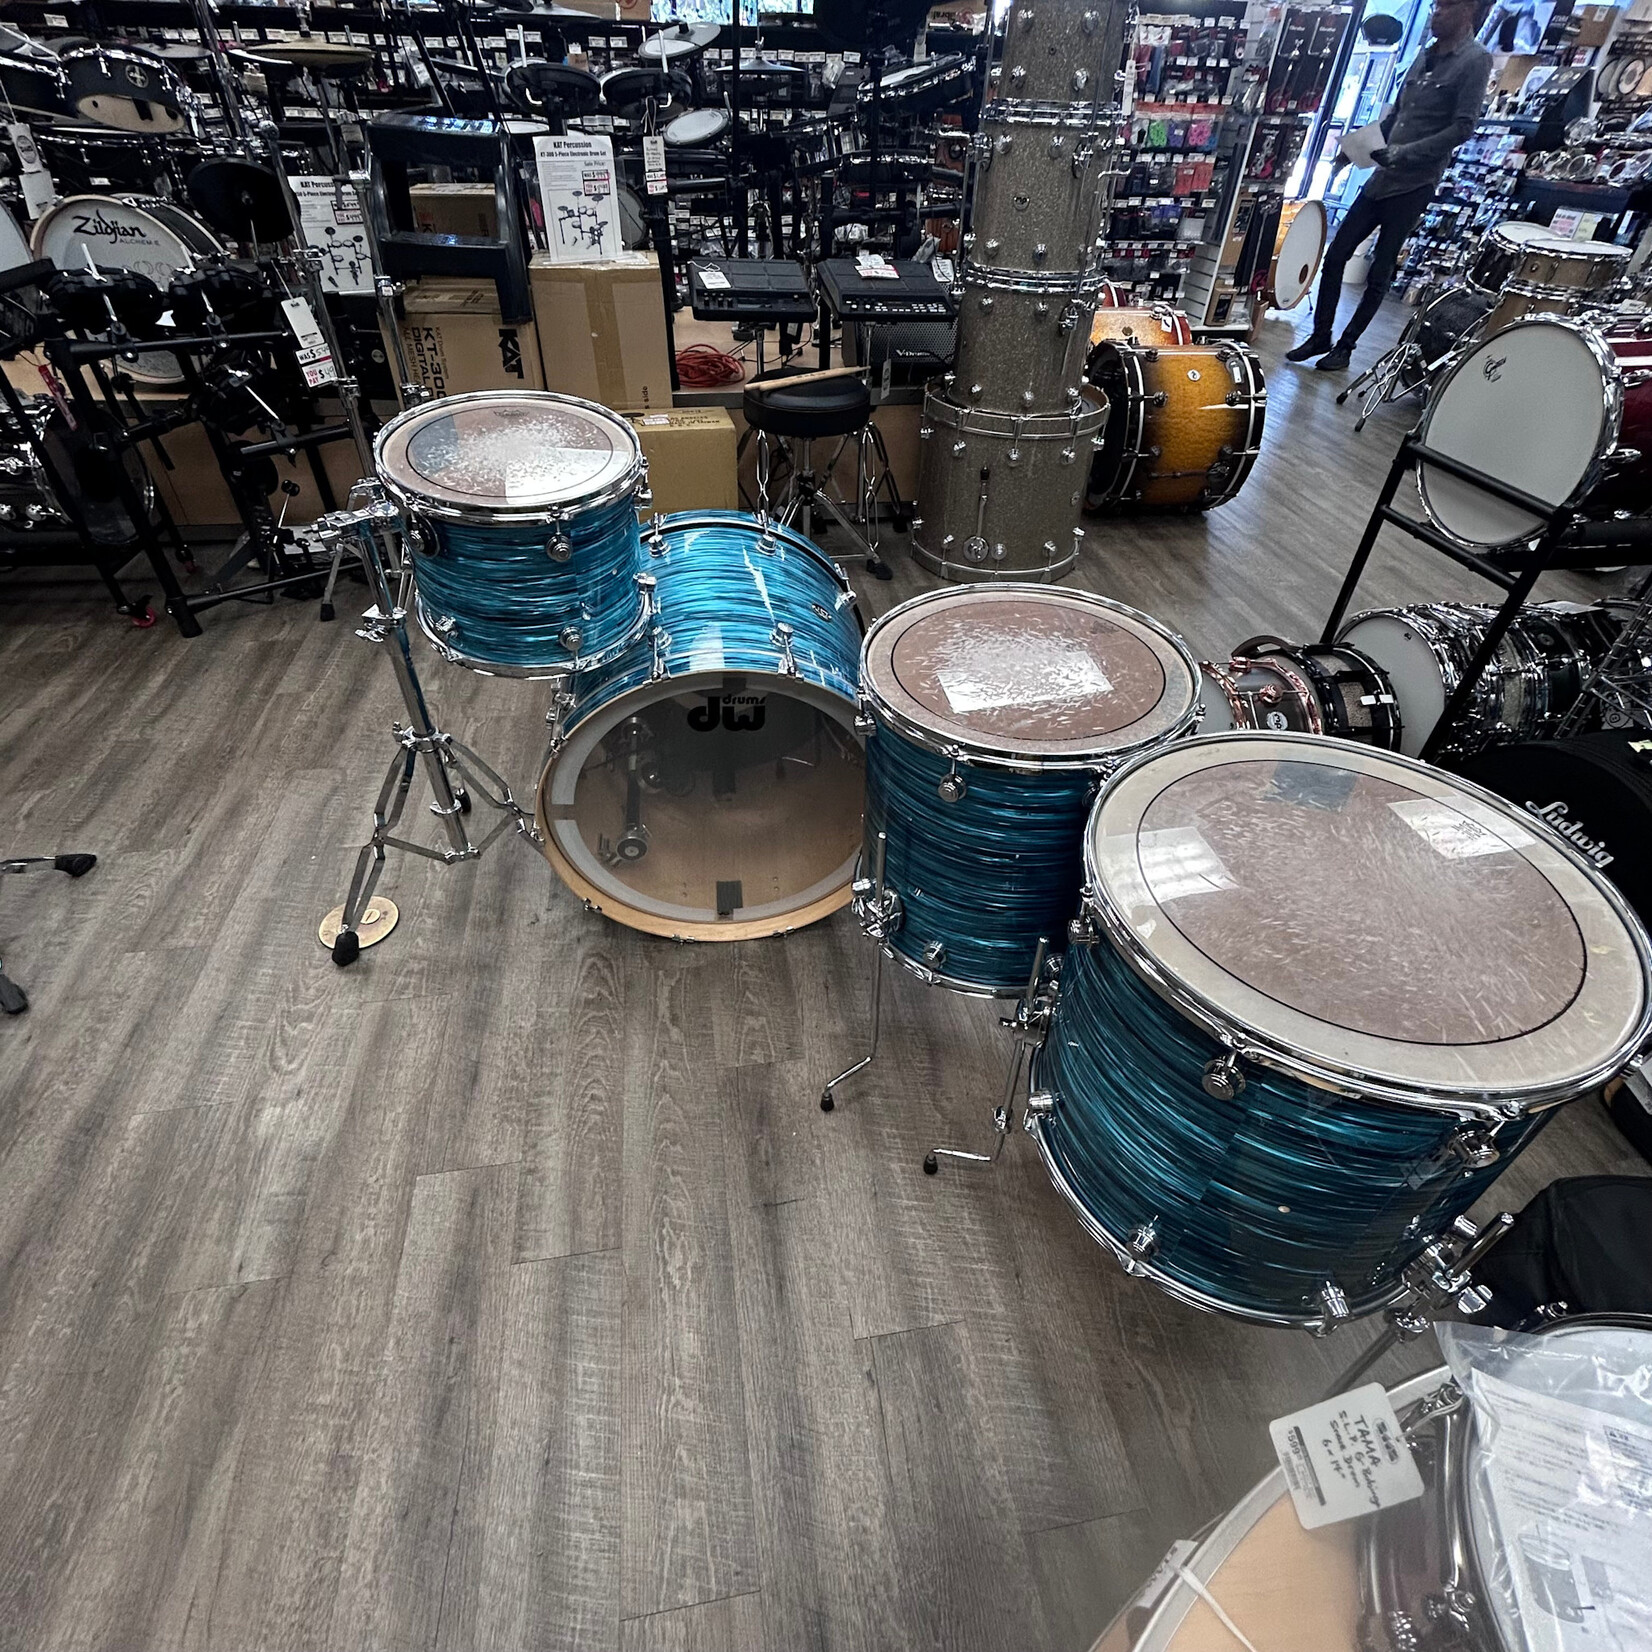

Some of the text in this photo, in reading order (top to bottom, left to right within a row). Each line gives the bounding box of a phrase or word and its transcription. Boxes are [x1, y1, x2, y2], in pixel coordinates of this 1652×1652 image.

[563, 141, 592, 149] Percussion
[72, 209, 147, 244] Zildjian
[299, 352, 311, 361] WAS
[405, 343, 419, 368] MESH
[411, 326, 431, 385] DIGITAL
[498, 328, 524, 379] KAT
[306, 369, 318, 378] YOU
[308, 377, 319, 385] PAY
[687, 696, 766, 732] dw
[722, 693, 767, 705] drums
[1525, 800, 1615, 868] Ludwig
[1330, 1420, 1361, 1488] Snare Drum
[1354, 1414, 1382, 1467] TAMA
